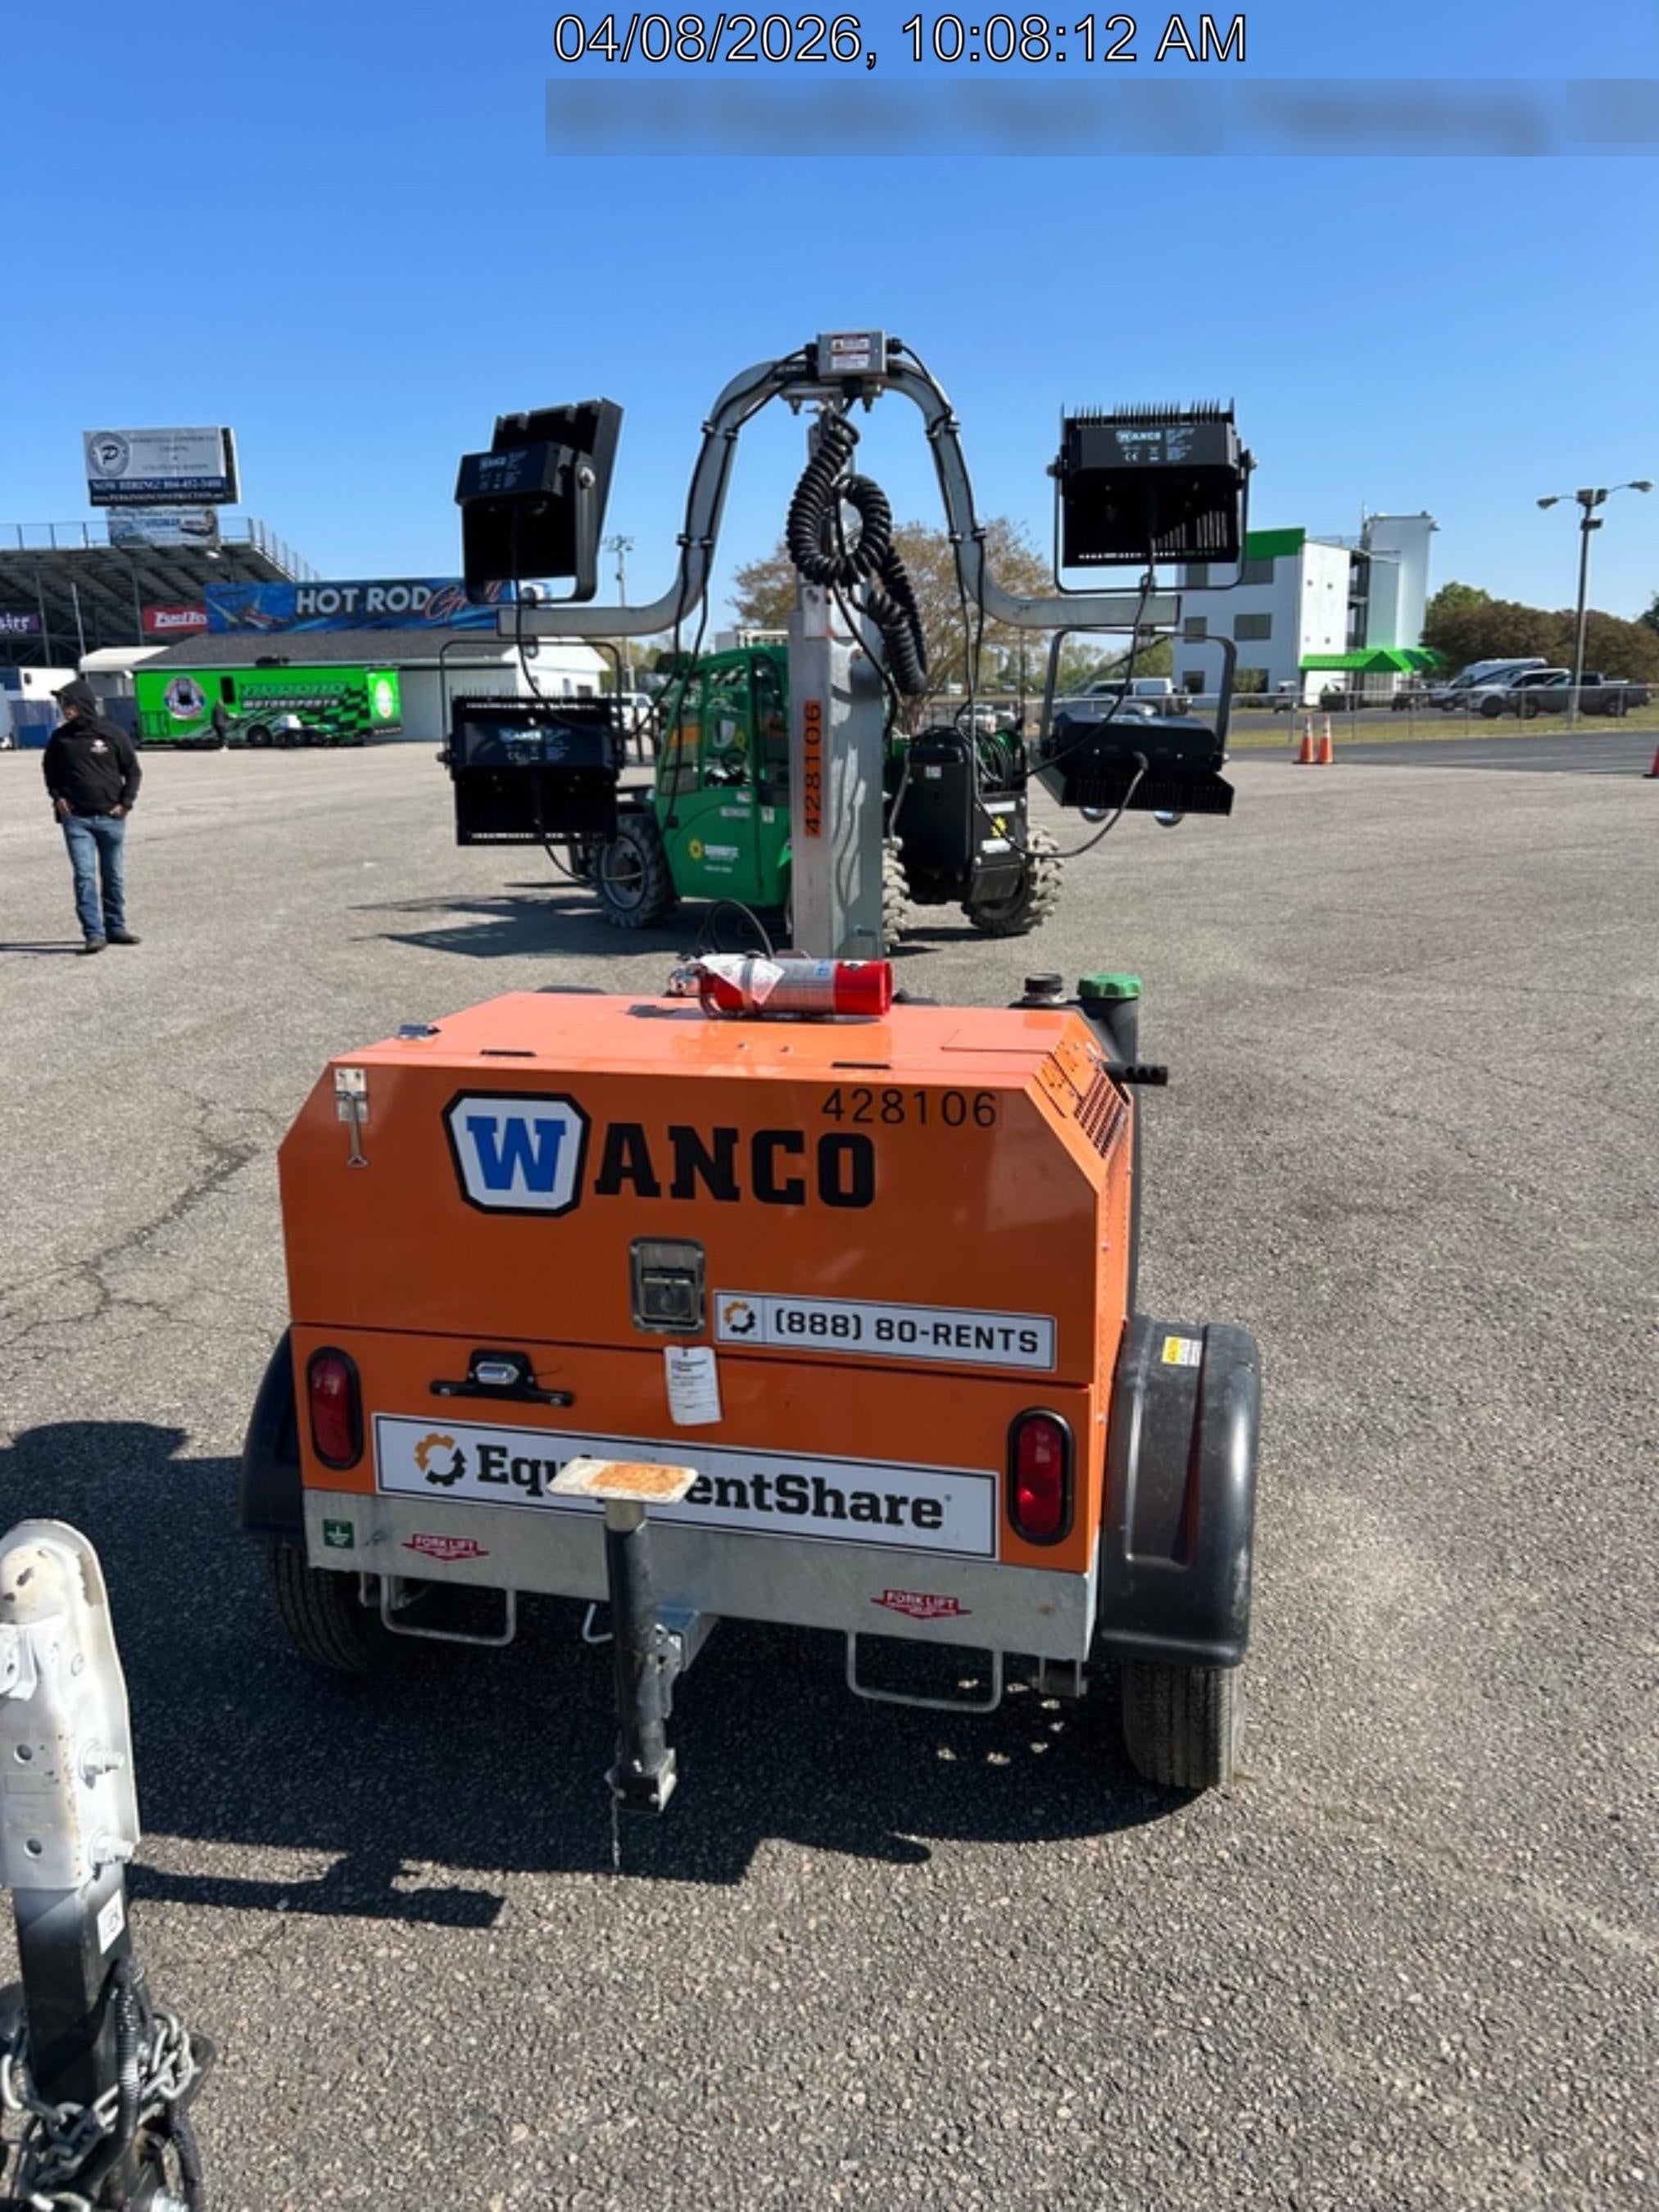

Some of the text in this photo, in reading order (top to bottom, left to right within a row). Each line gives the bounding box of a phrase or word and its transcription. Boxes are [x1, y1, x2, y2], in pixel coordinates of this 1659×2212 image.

[297, 587, 359, 614] HOT
[366, 586, 432, 612] ROD
[804, 704, 822, 834] 428106
[821, 1088, 997, 1127] 428106
[465, 1114, 877, 1209] WANCO
[775, 1308, 1038, 1353] (888) 80-RENTS
[475, 1443, 944, 1530] EqentShare
